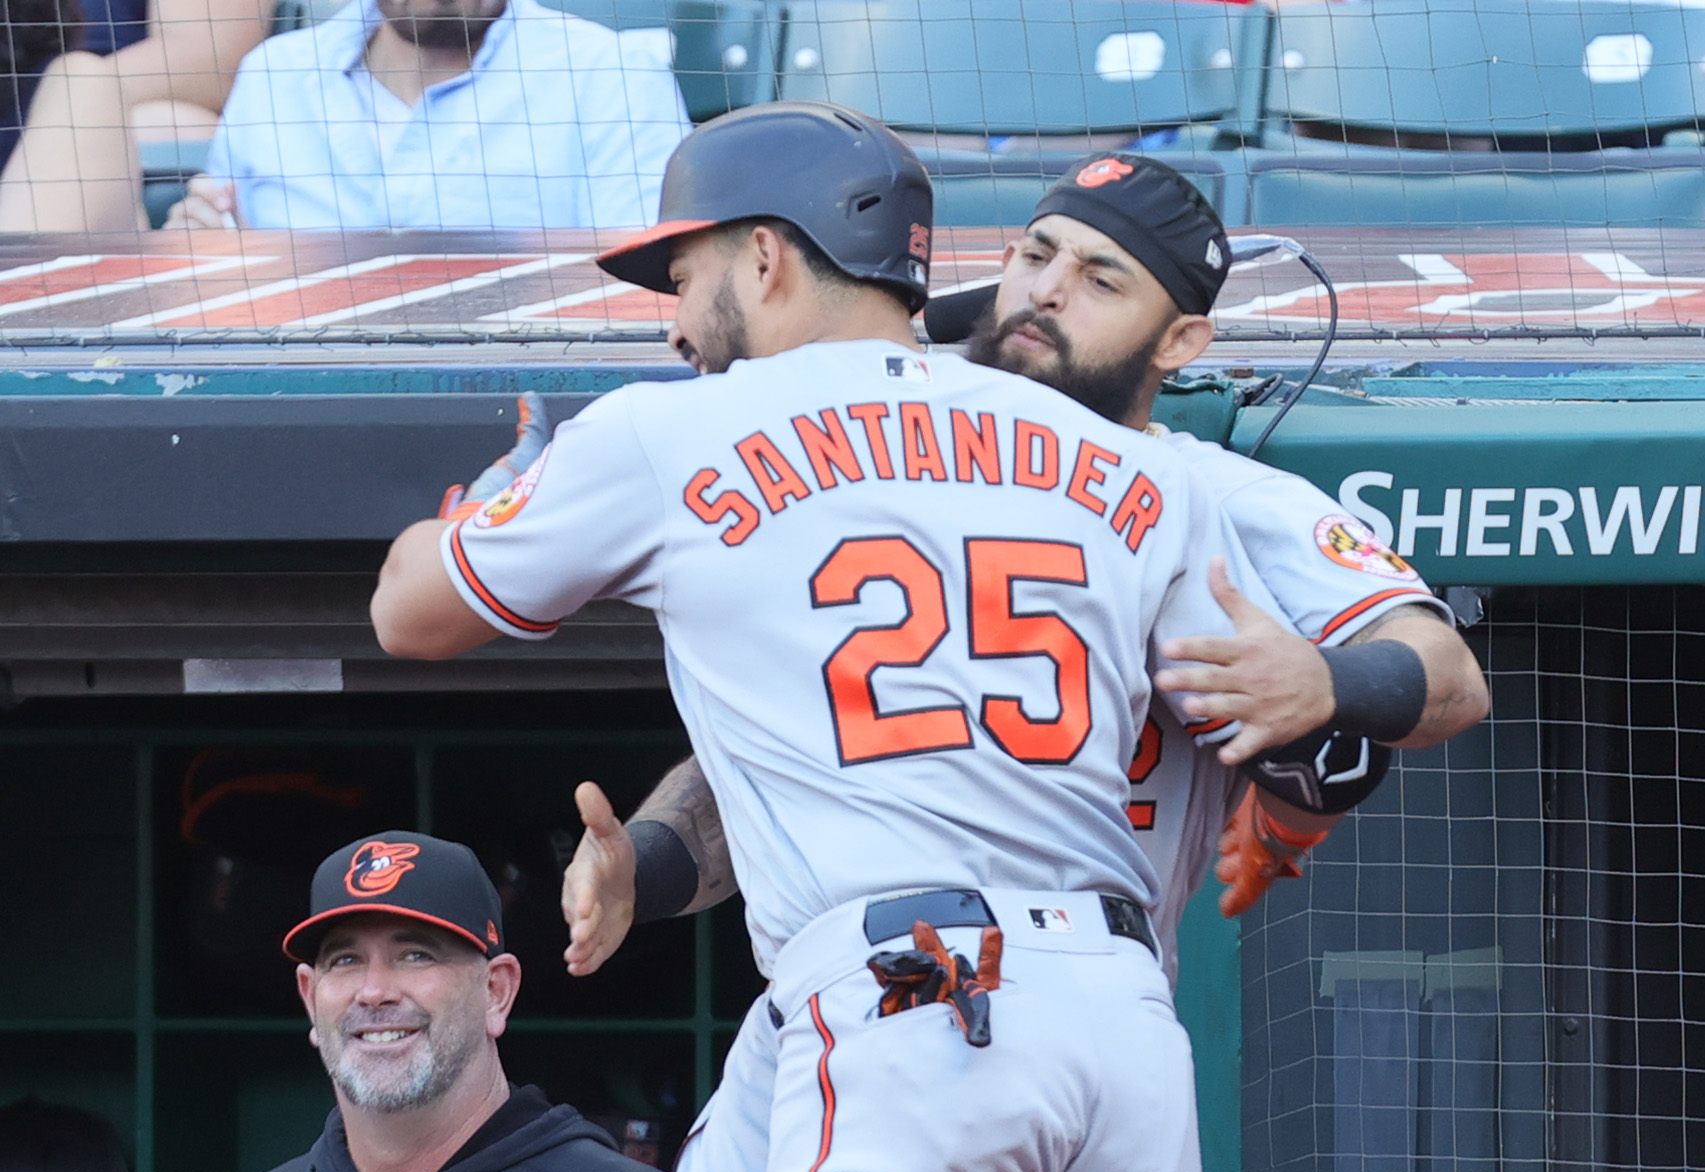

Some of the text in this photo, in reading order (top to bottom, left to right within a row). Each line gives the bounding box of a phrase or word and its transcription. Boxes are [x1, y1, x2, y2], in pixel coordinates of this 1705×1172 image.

[683, 401, 1163, 556] SANTANDER
[1338, 470, 1702, 557] SHERWI
[808, 534, 1093, 768] 25
